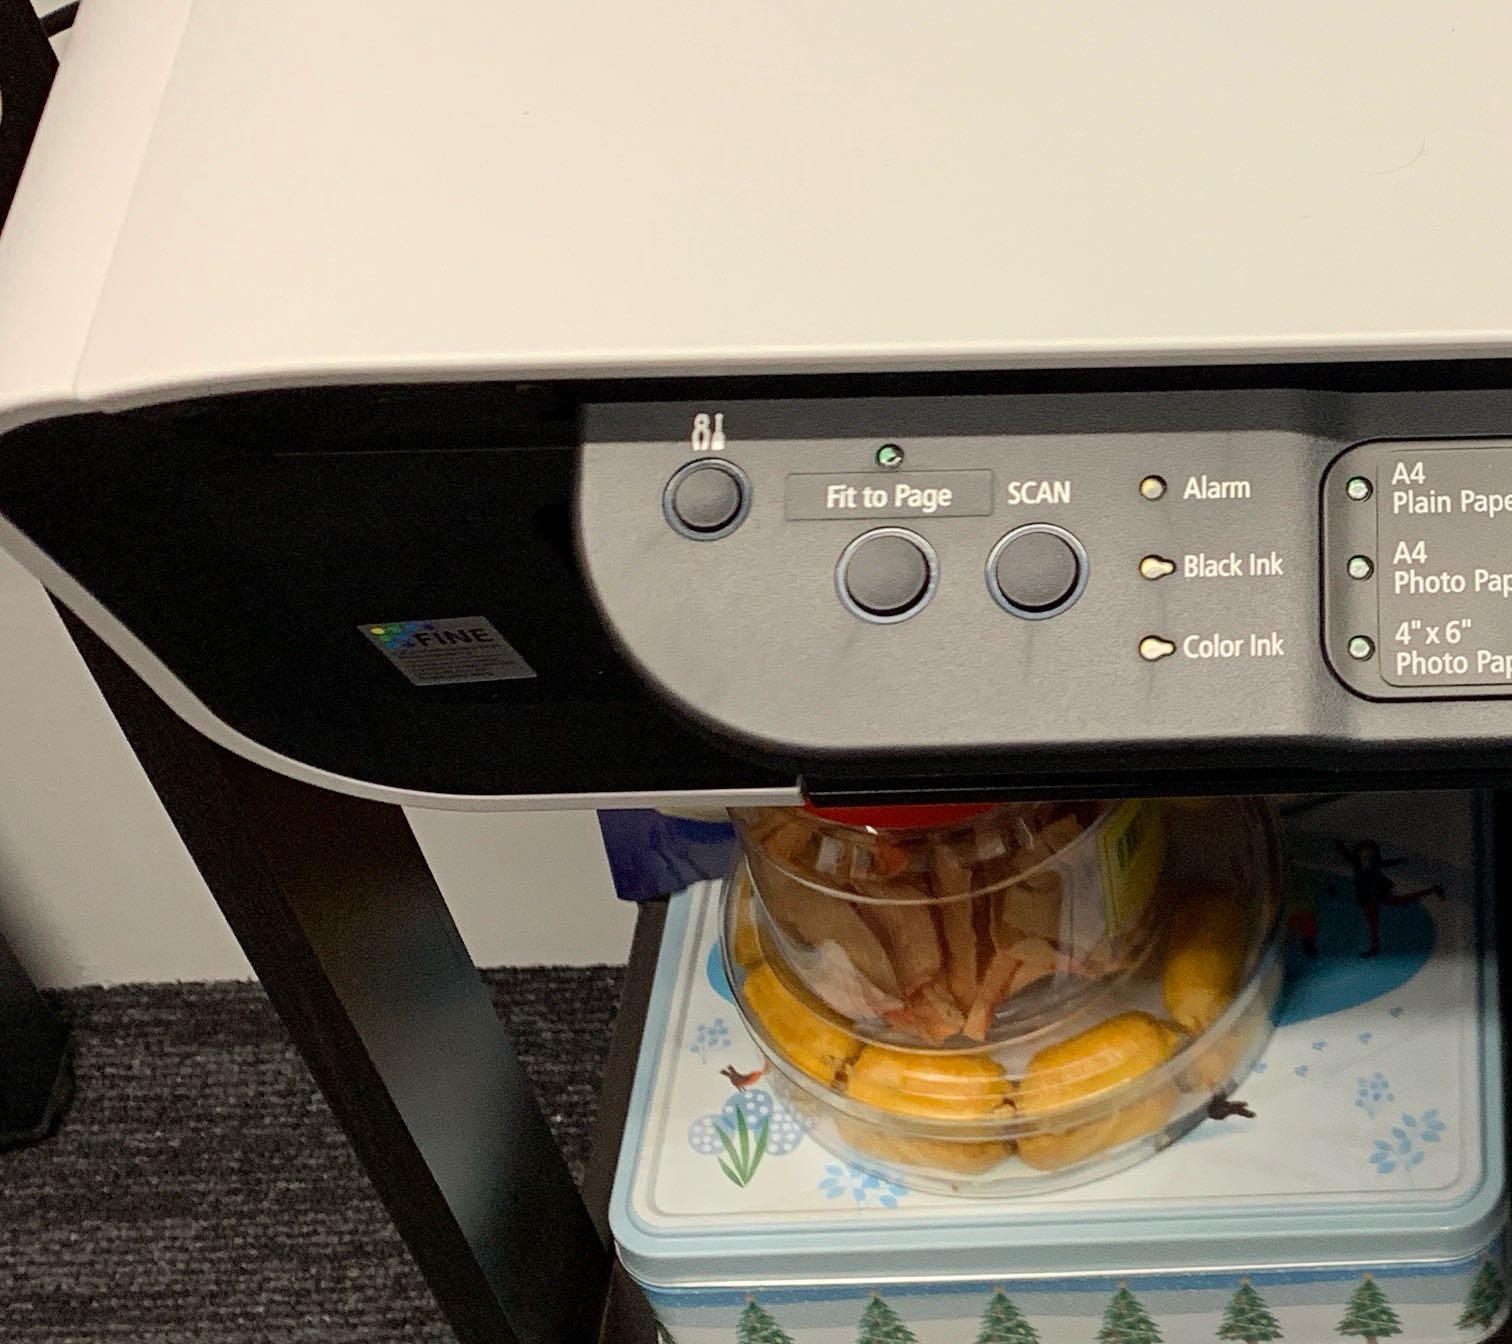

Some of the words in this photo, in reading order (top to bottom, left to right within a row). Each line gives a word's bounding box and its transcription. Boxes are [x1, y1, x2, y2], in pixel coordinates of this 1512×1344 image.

[1392, 461, 1426, 485] A4
[826, 484, 855, 508] Fit
[863, 486, 887, 508] to
[894, 484, 953, 513] Page
[1007, 481, 1071, 505] SCAN
[1183, 477, 1251, 500] Alarm
[1392, 490, 1452, 514] Plain
[1393, 540, 1428, 565] A4
[1183, 555, 1243, 578] Black
[1250, 552, 1284, 576] Ink
[1394, 570, 1466, 594] Photo
[414, 628, 495, 647] FINE
[1183, 635, 1244, 659] Color
[1251, 633, 1285, 657] Ink
[1396, 651, 1468, 676] Photo
